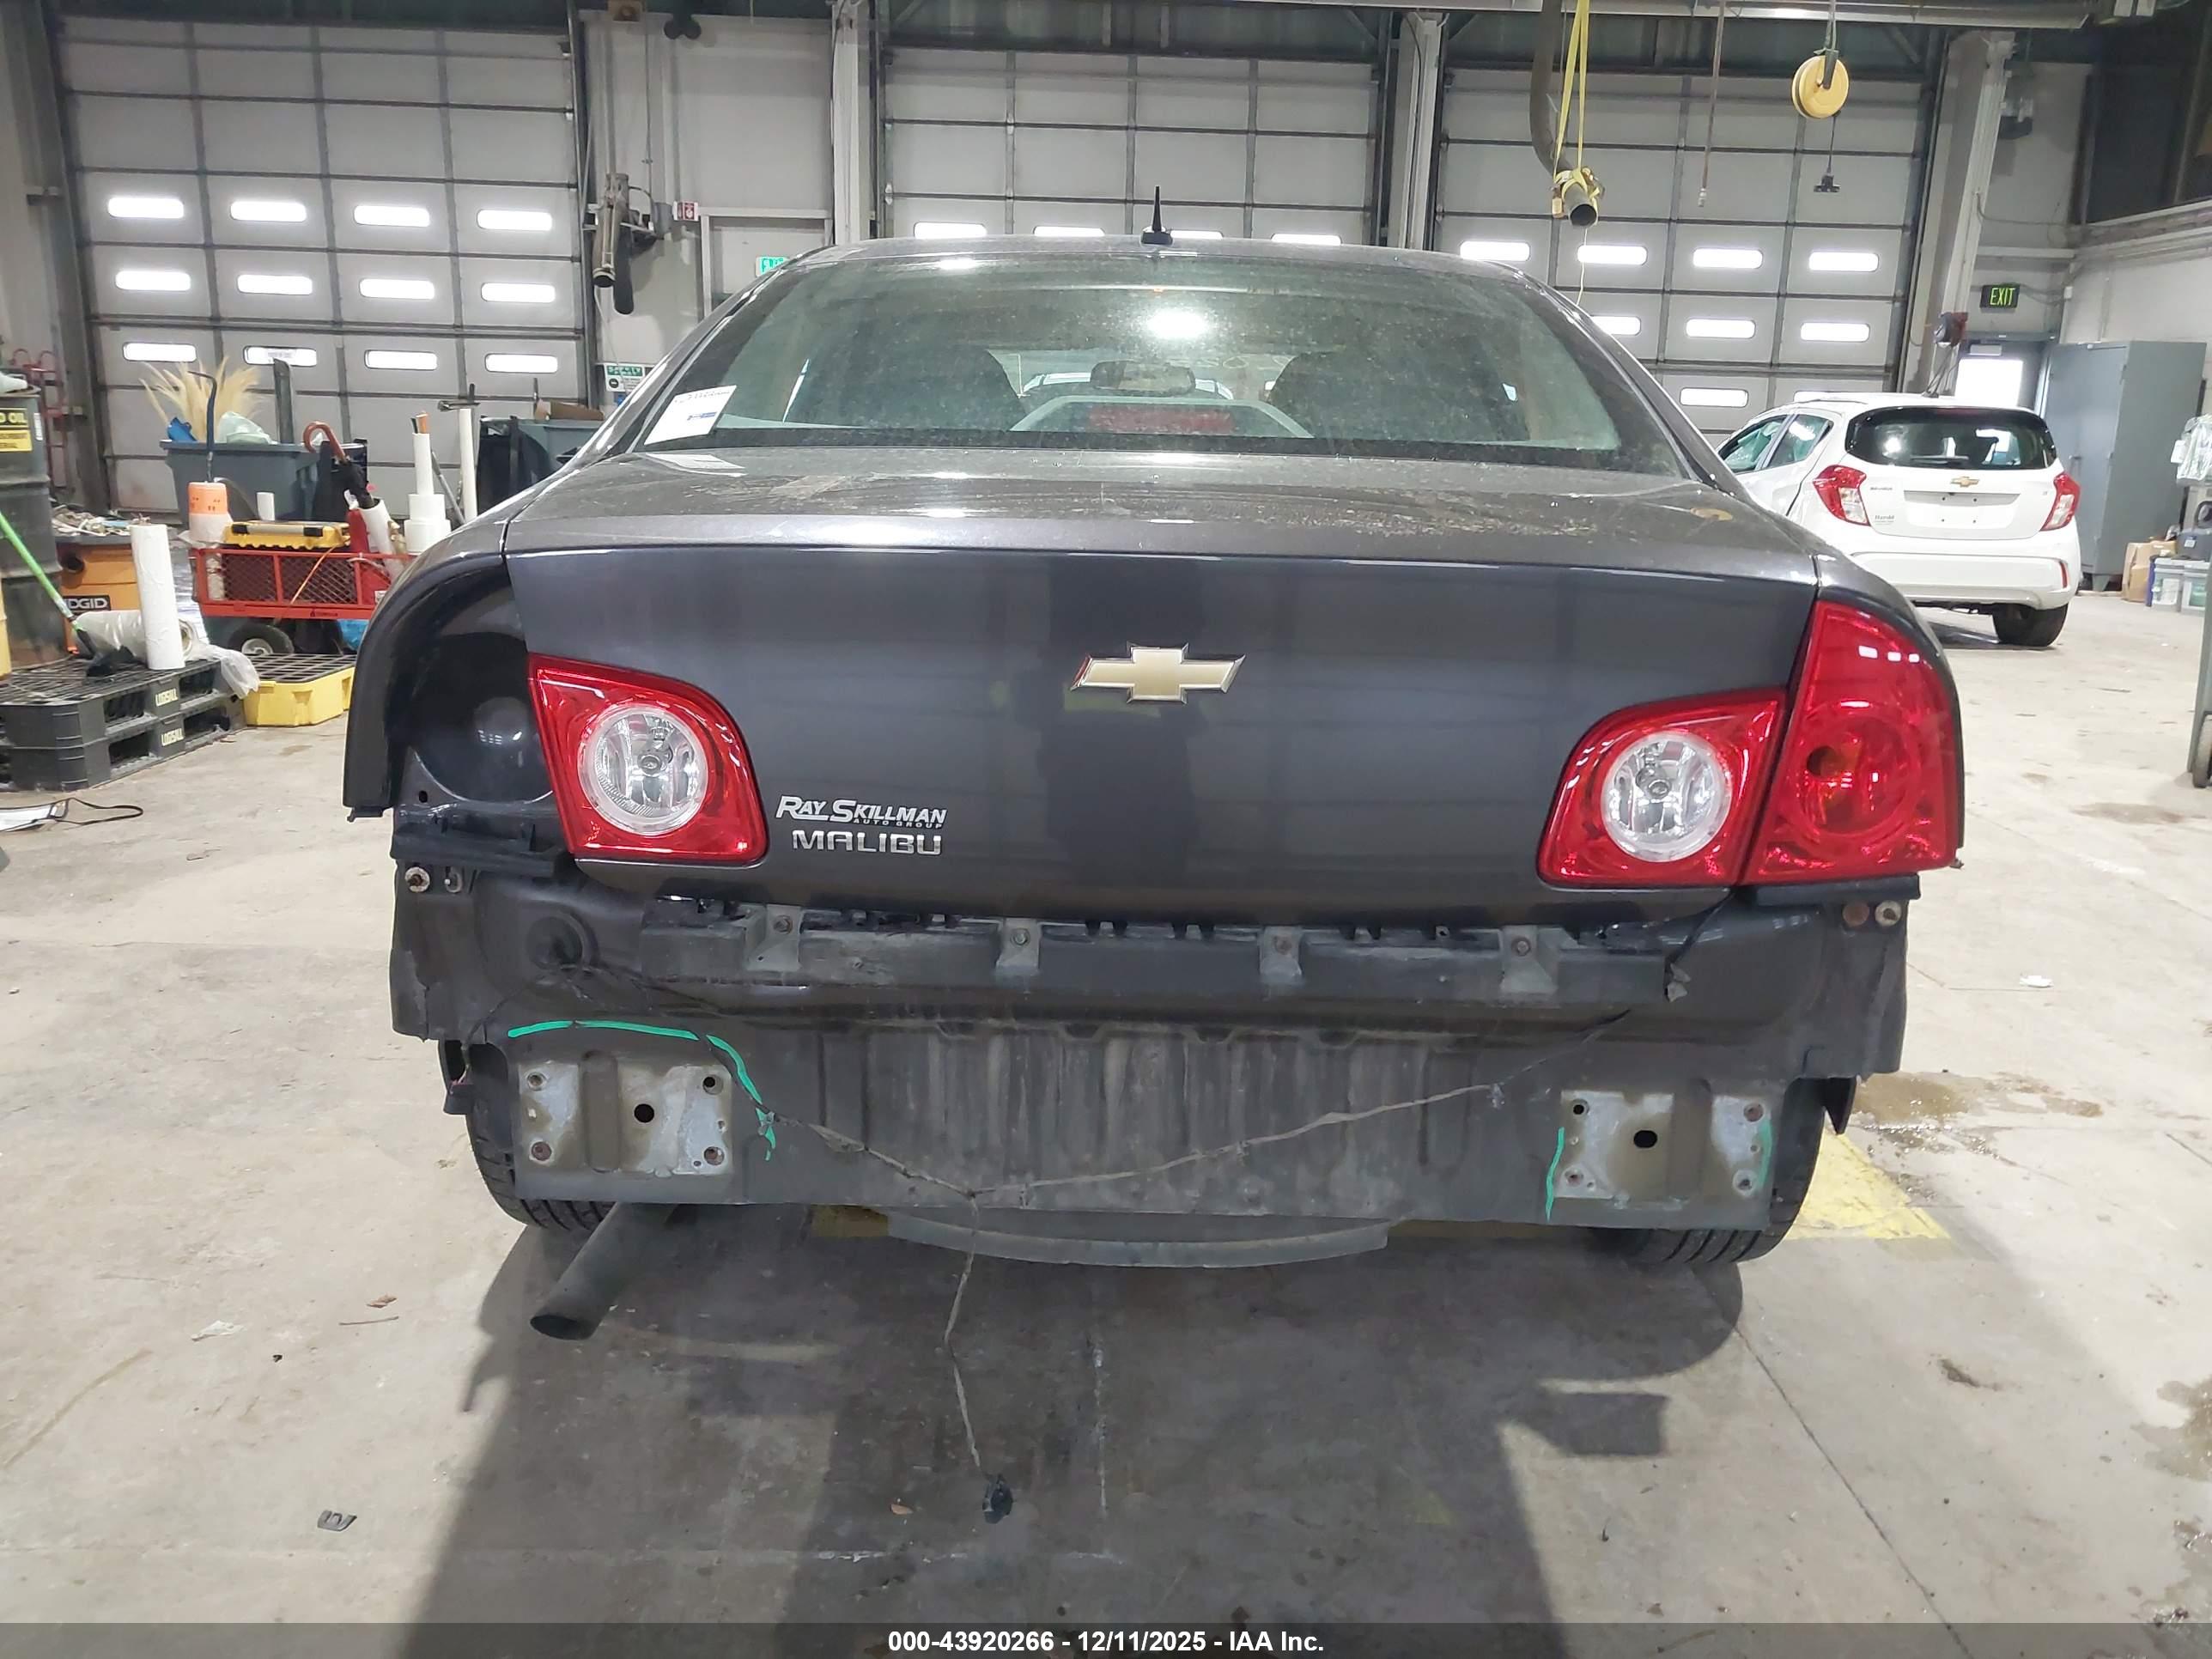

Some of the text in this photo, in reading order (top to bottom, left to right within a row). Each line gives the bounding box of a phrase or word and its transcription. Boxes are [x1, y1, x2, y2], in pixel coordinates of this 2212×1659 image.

[1990, 287, 2015, 306] EXIT
[776, 795, 948, 824] RAY SKILLMAN
[793, 830, 942, 855] MALIBU
